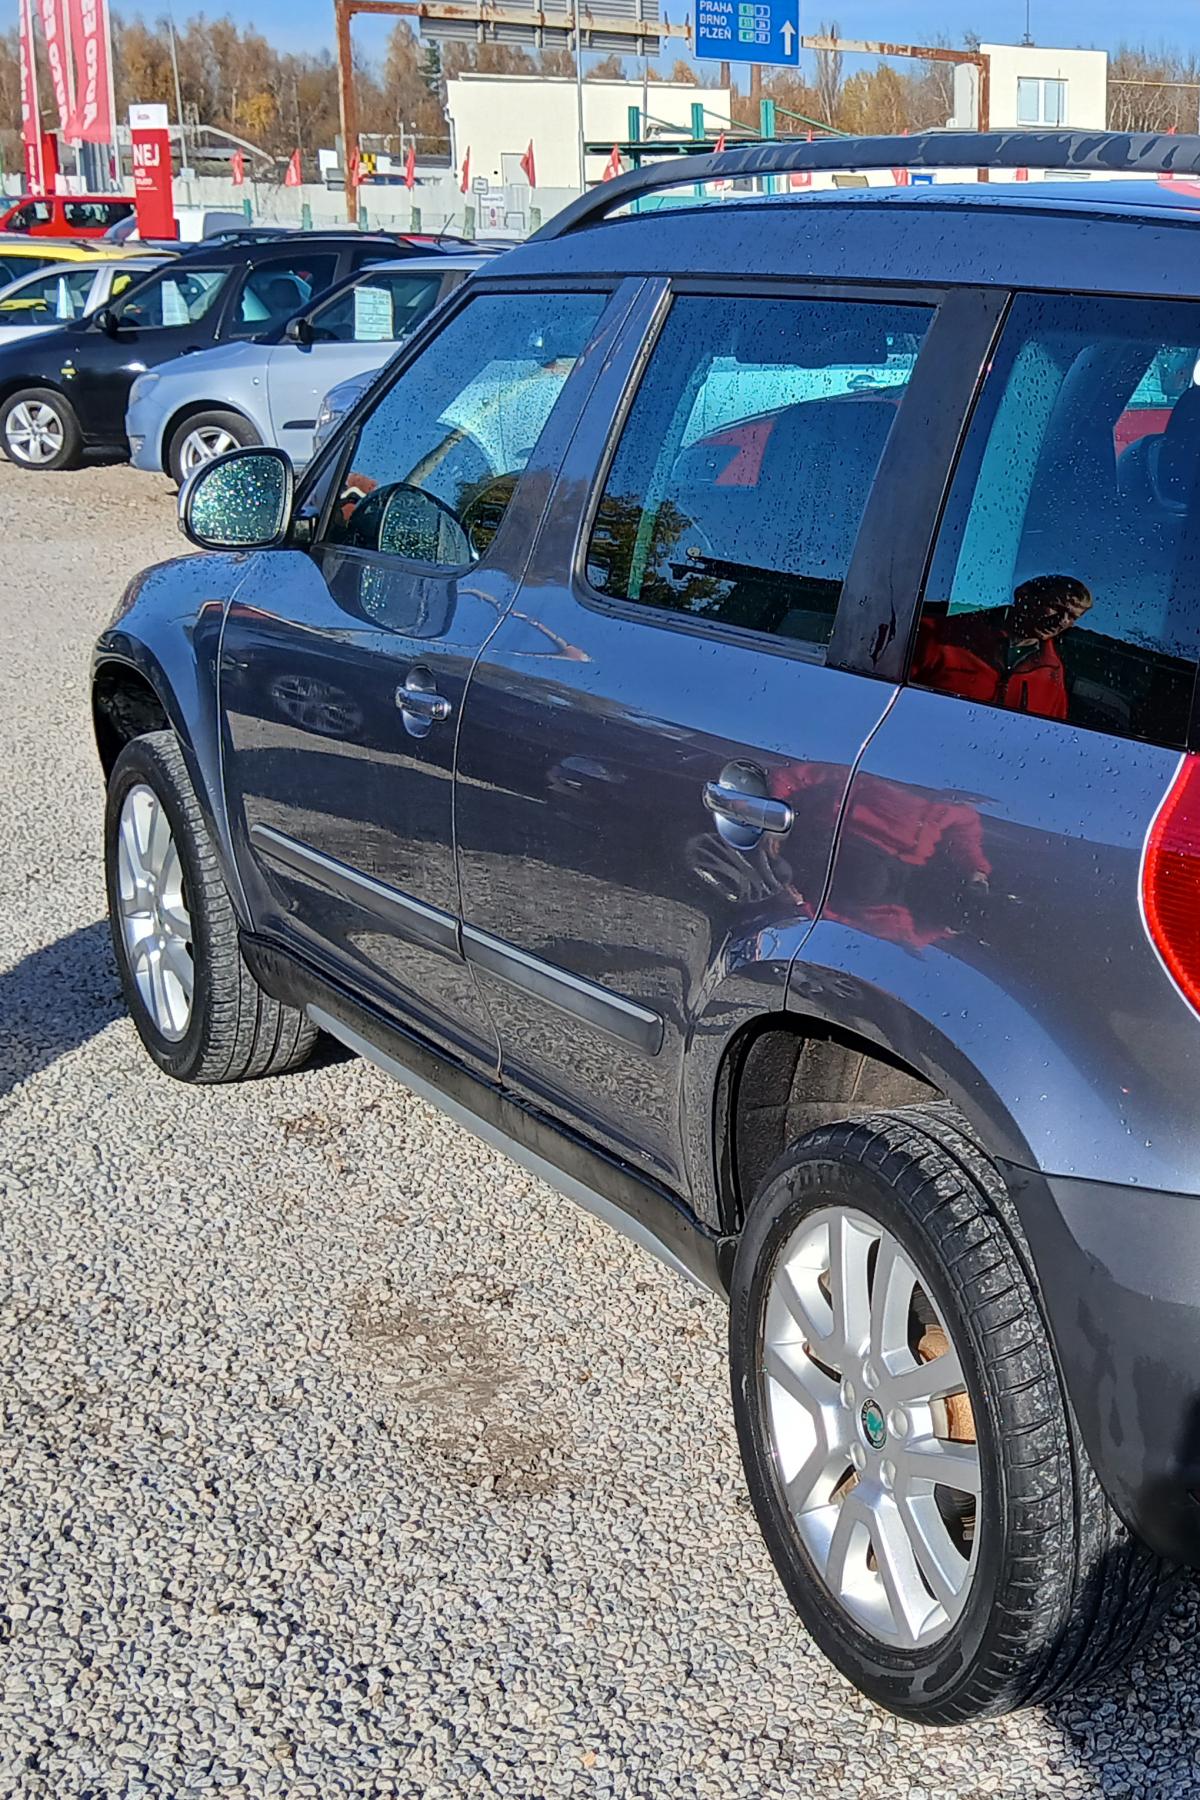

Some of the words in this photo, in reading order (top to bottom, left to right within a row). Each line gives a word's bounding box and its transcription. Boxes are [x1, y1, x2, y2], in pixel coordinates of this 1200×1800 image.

[699, 1, 733, 14] PRAHA
[699, 13, 728, 26] BRNO
[132, 143, 160, 167] NEJ
